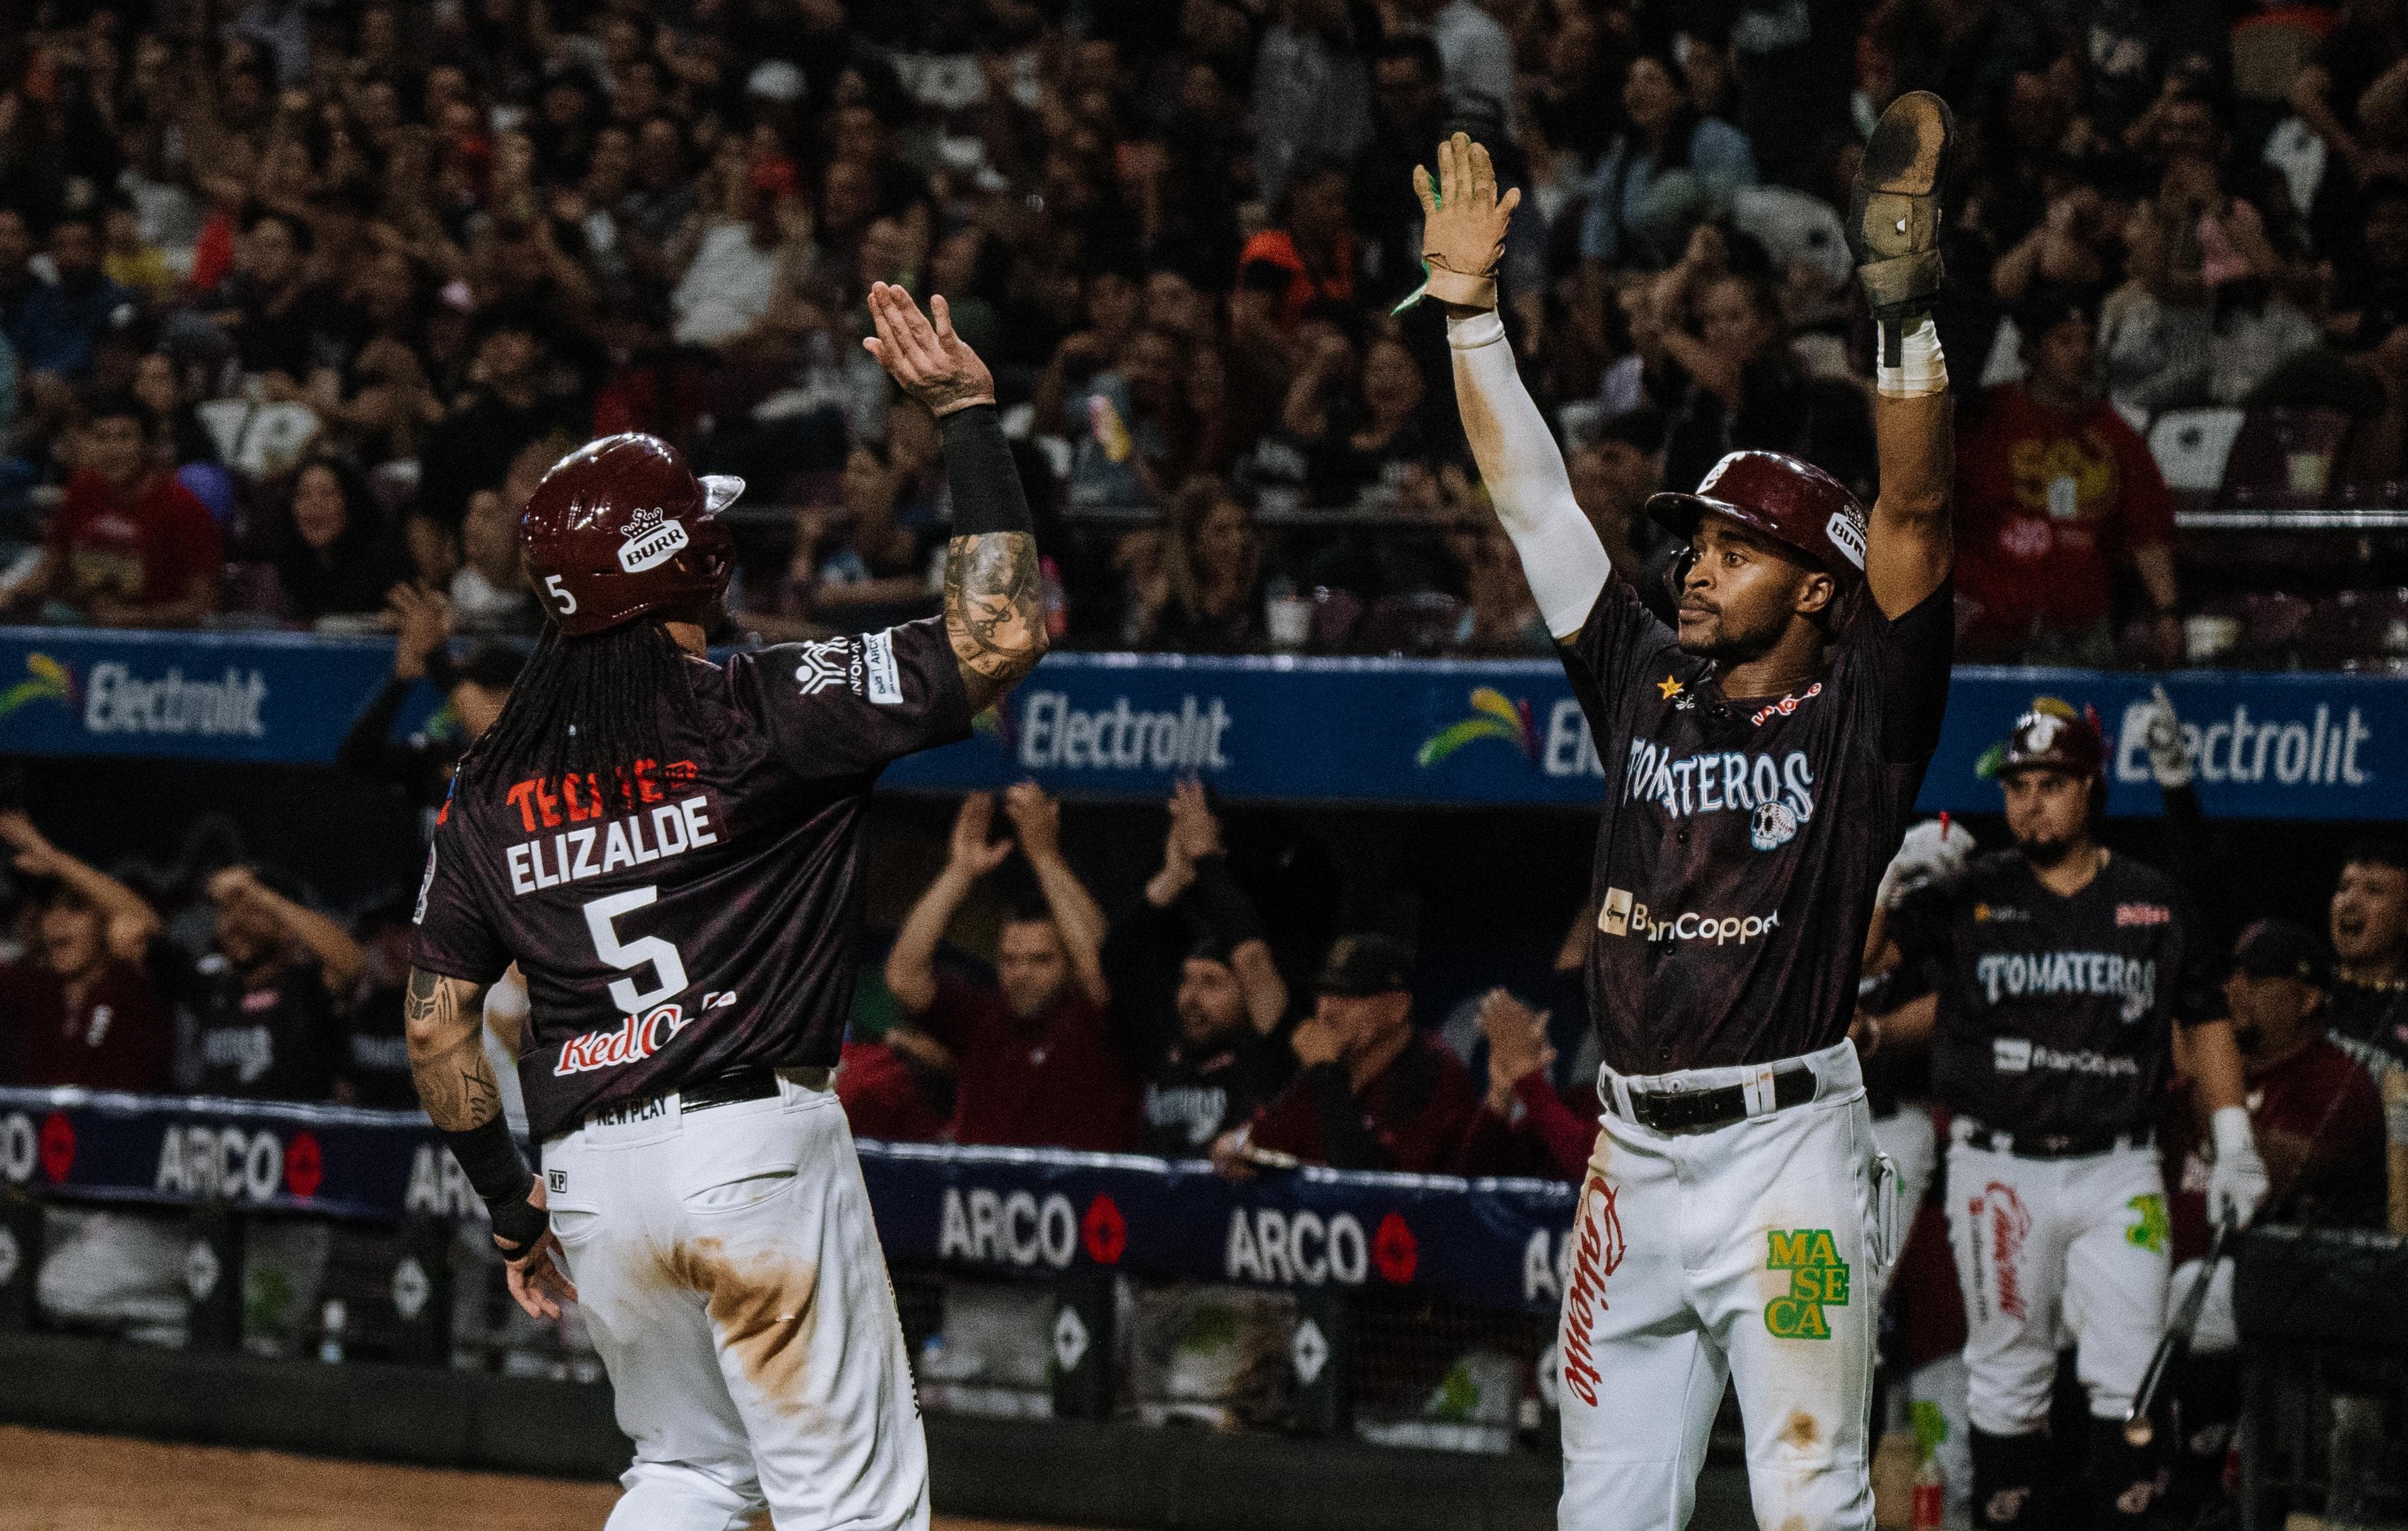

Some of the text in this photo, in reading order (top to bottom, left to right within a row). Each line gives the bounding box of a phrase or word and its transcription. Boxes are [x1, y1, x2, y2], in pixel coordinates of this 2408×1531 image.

[626, 529, 685, 567] BURR
[1832, 520, 1864, 559] BUR
[545, 574, 577, 615] 5
[87, 661, 268, 736] Electrolit
[1019, 691, 1232, 770] Electrolit
[1623, 736, 1814, 823] TOMATEROS
[506, 795, 717, 895] ELIZALDE
[583, 885, 689, 1015] 5
[597, 1096, 666, 1126] NEW PLAY
[156, 1125, 284, 1203] ARCO
[550, 1173, 565, 1191] NP
[940, 1189, 1076, 1268] ARCO
[1227, 1210, 1368, 1285] ARCO
[1769, 1231, 1840, 1267] MA
[1565, 1176, 1627, 1407] Caliente
